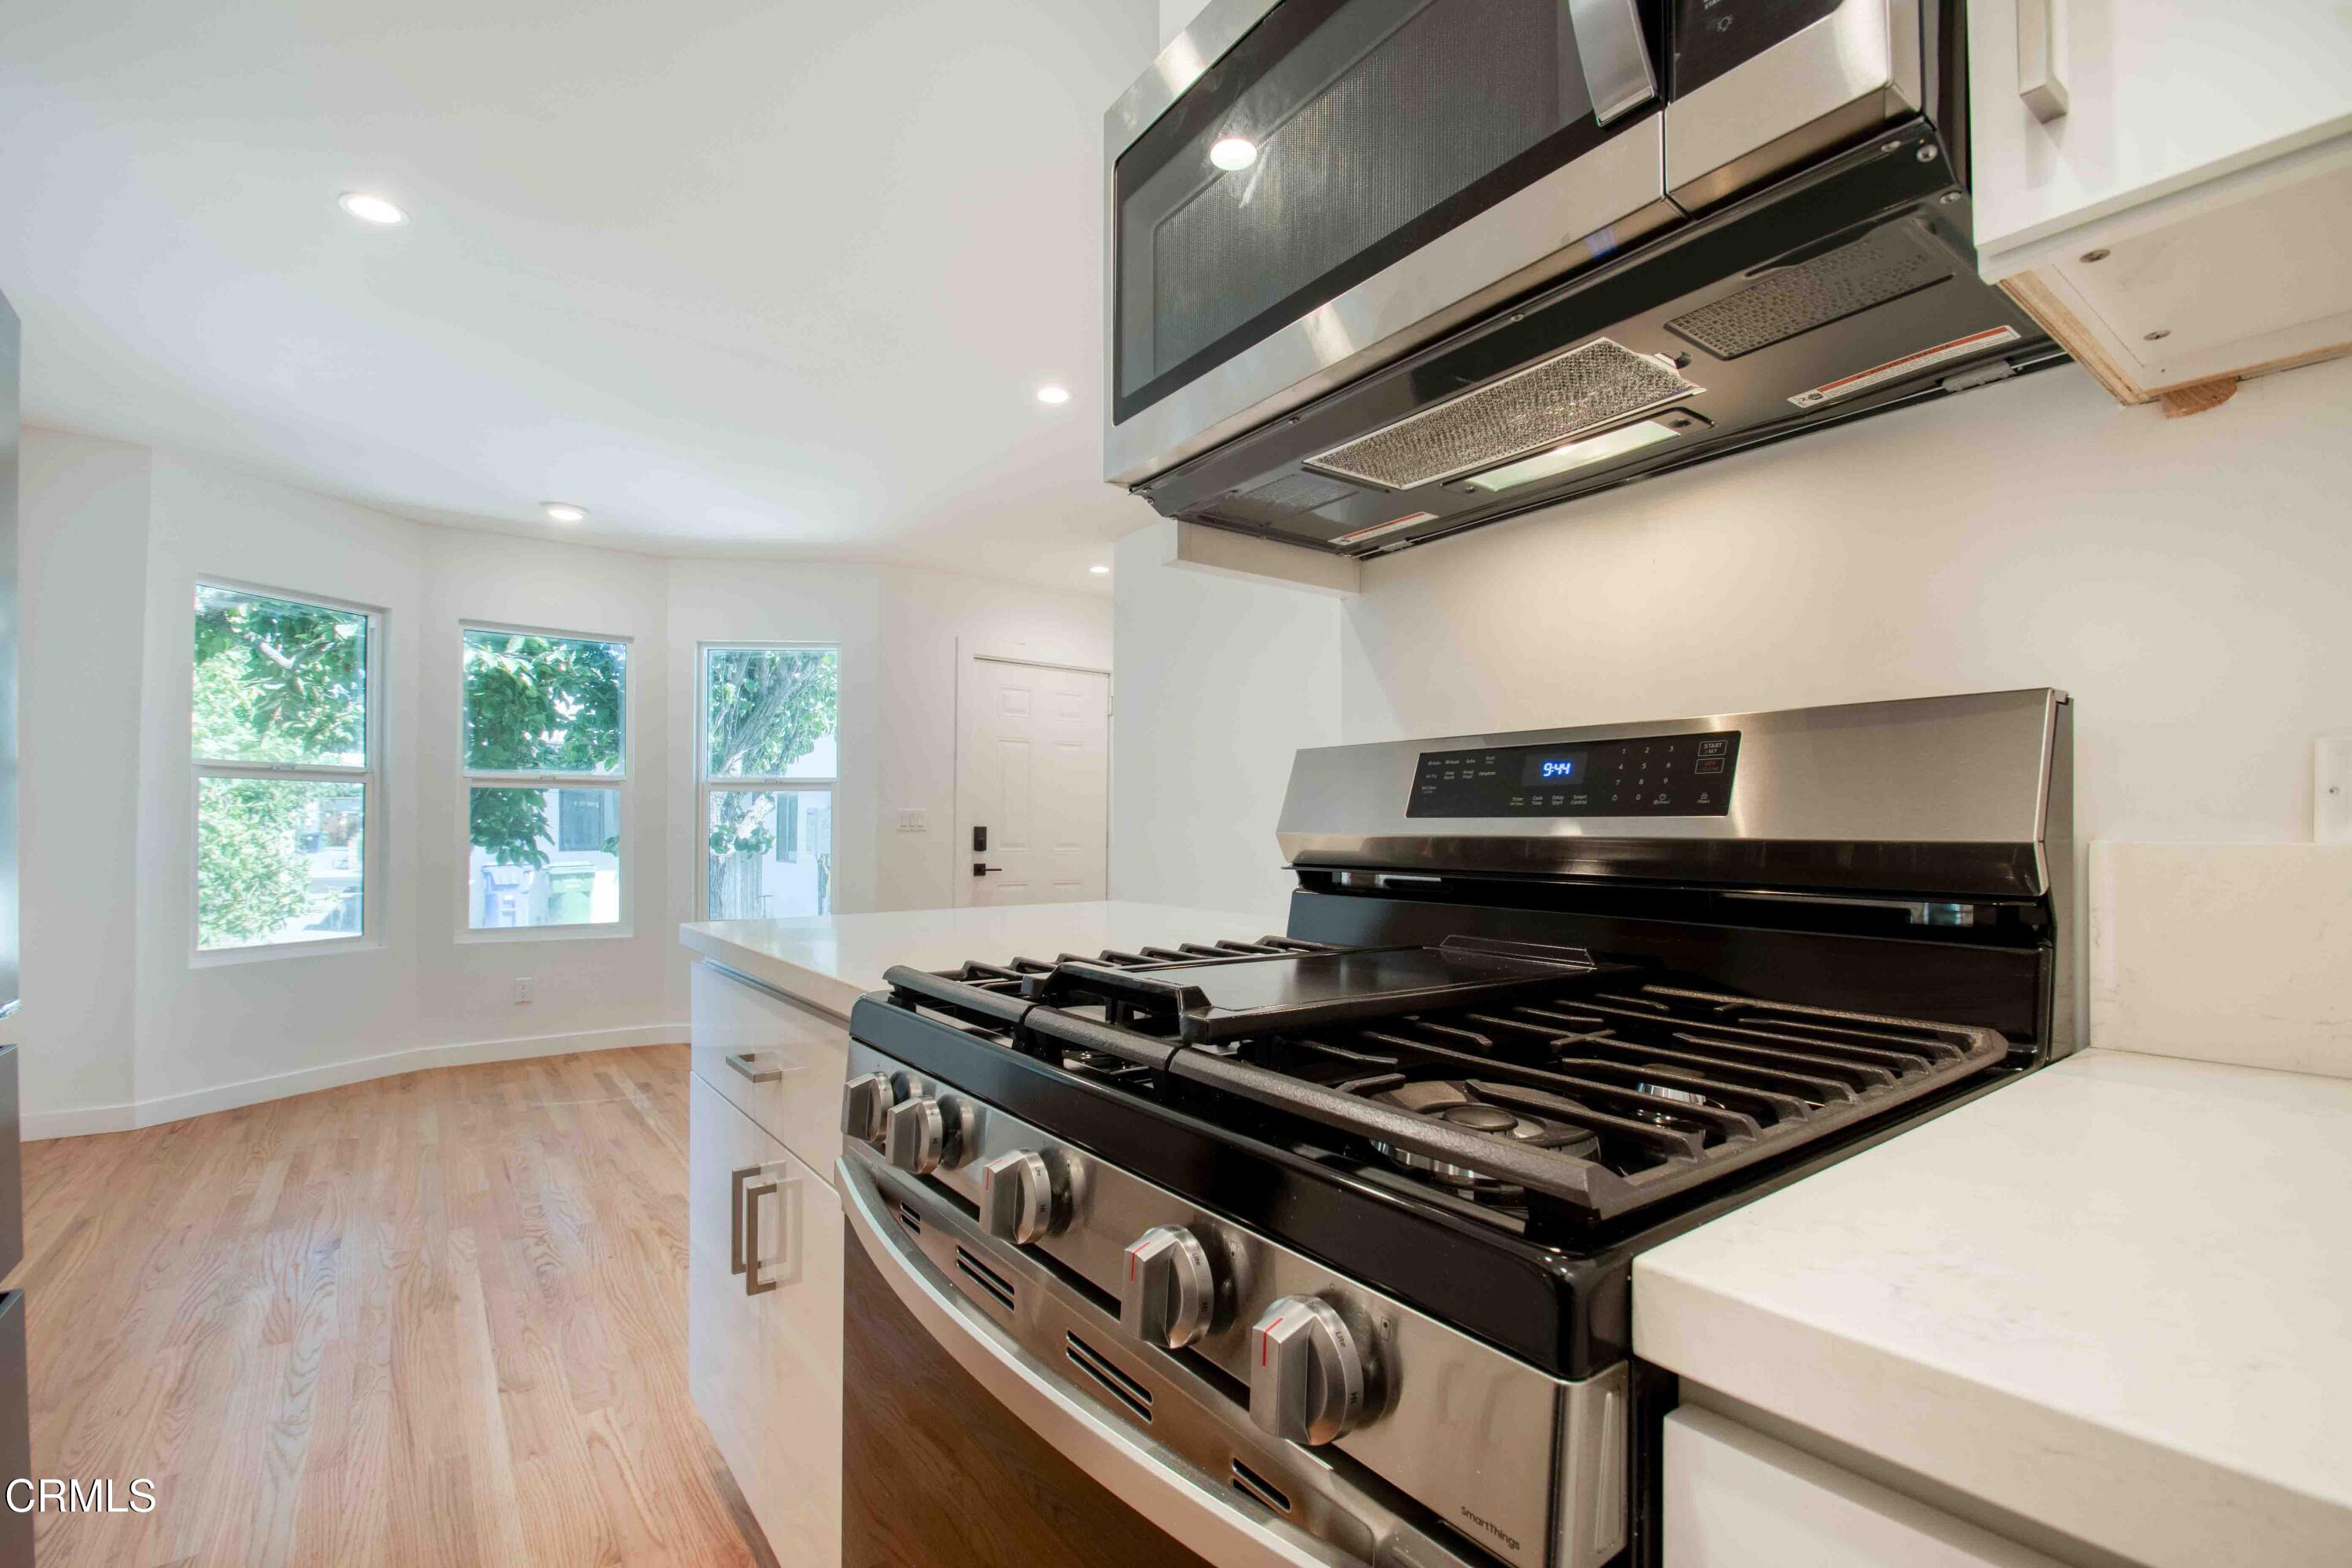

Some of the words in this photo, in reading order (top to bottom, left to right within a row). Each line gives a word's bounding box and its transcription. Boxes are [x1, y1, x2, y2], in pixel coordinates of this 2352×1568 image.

[1543, 762, 1572, 777] 9:44
[1192, 1253, 1200, 1266] Lite
[1335, 1331, 1345, 1348] Lite
[1461, 1506, 1521, 1550] SmartThings
